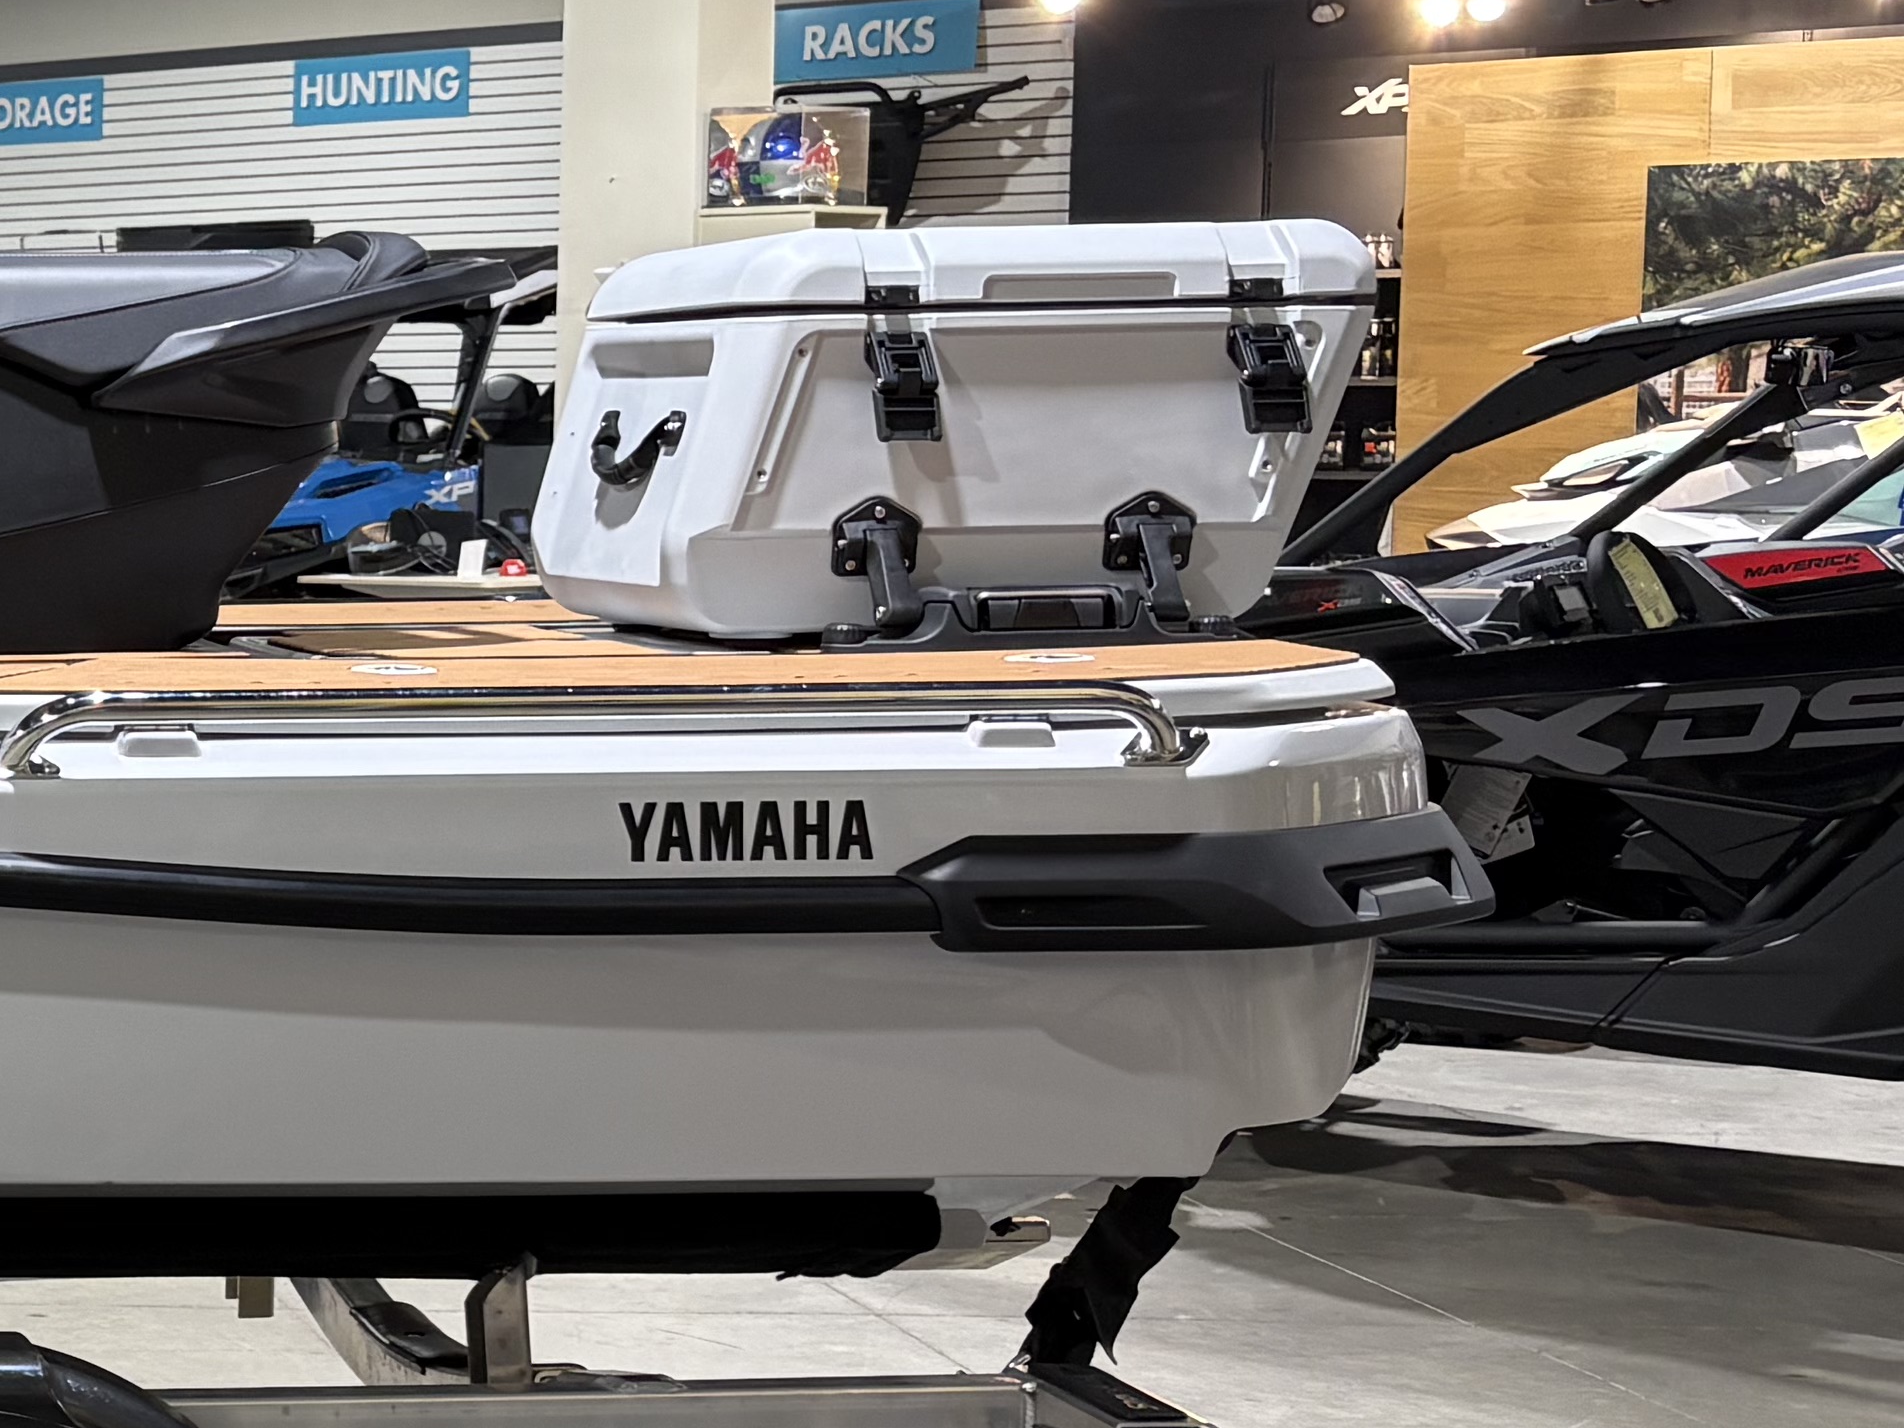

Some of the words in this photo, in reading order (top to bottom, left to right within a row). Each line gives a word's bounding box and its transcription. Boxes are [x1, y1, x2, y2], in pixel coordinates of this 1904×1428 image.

[802, 15, 936, 62] RACKS
[299, 65, 461, 109] HUNTING
[1743, 552, 1861, 579] MAVERICK
[618, 800, 875, 863] YAMAHA
